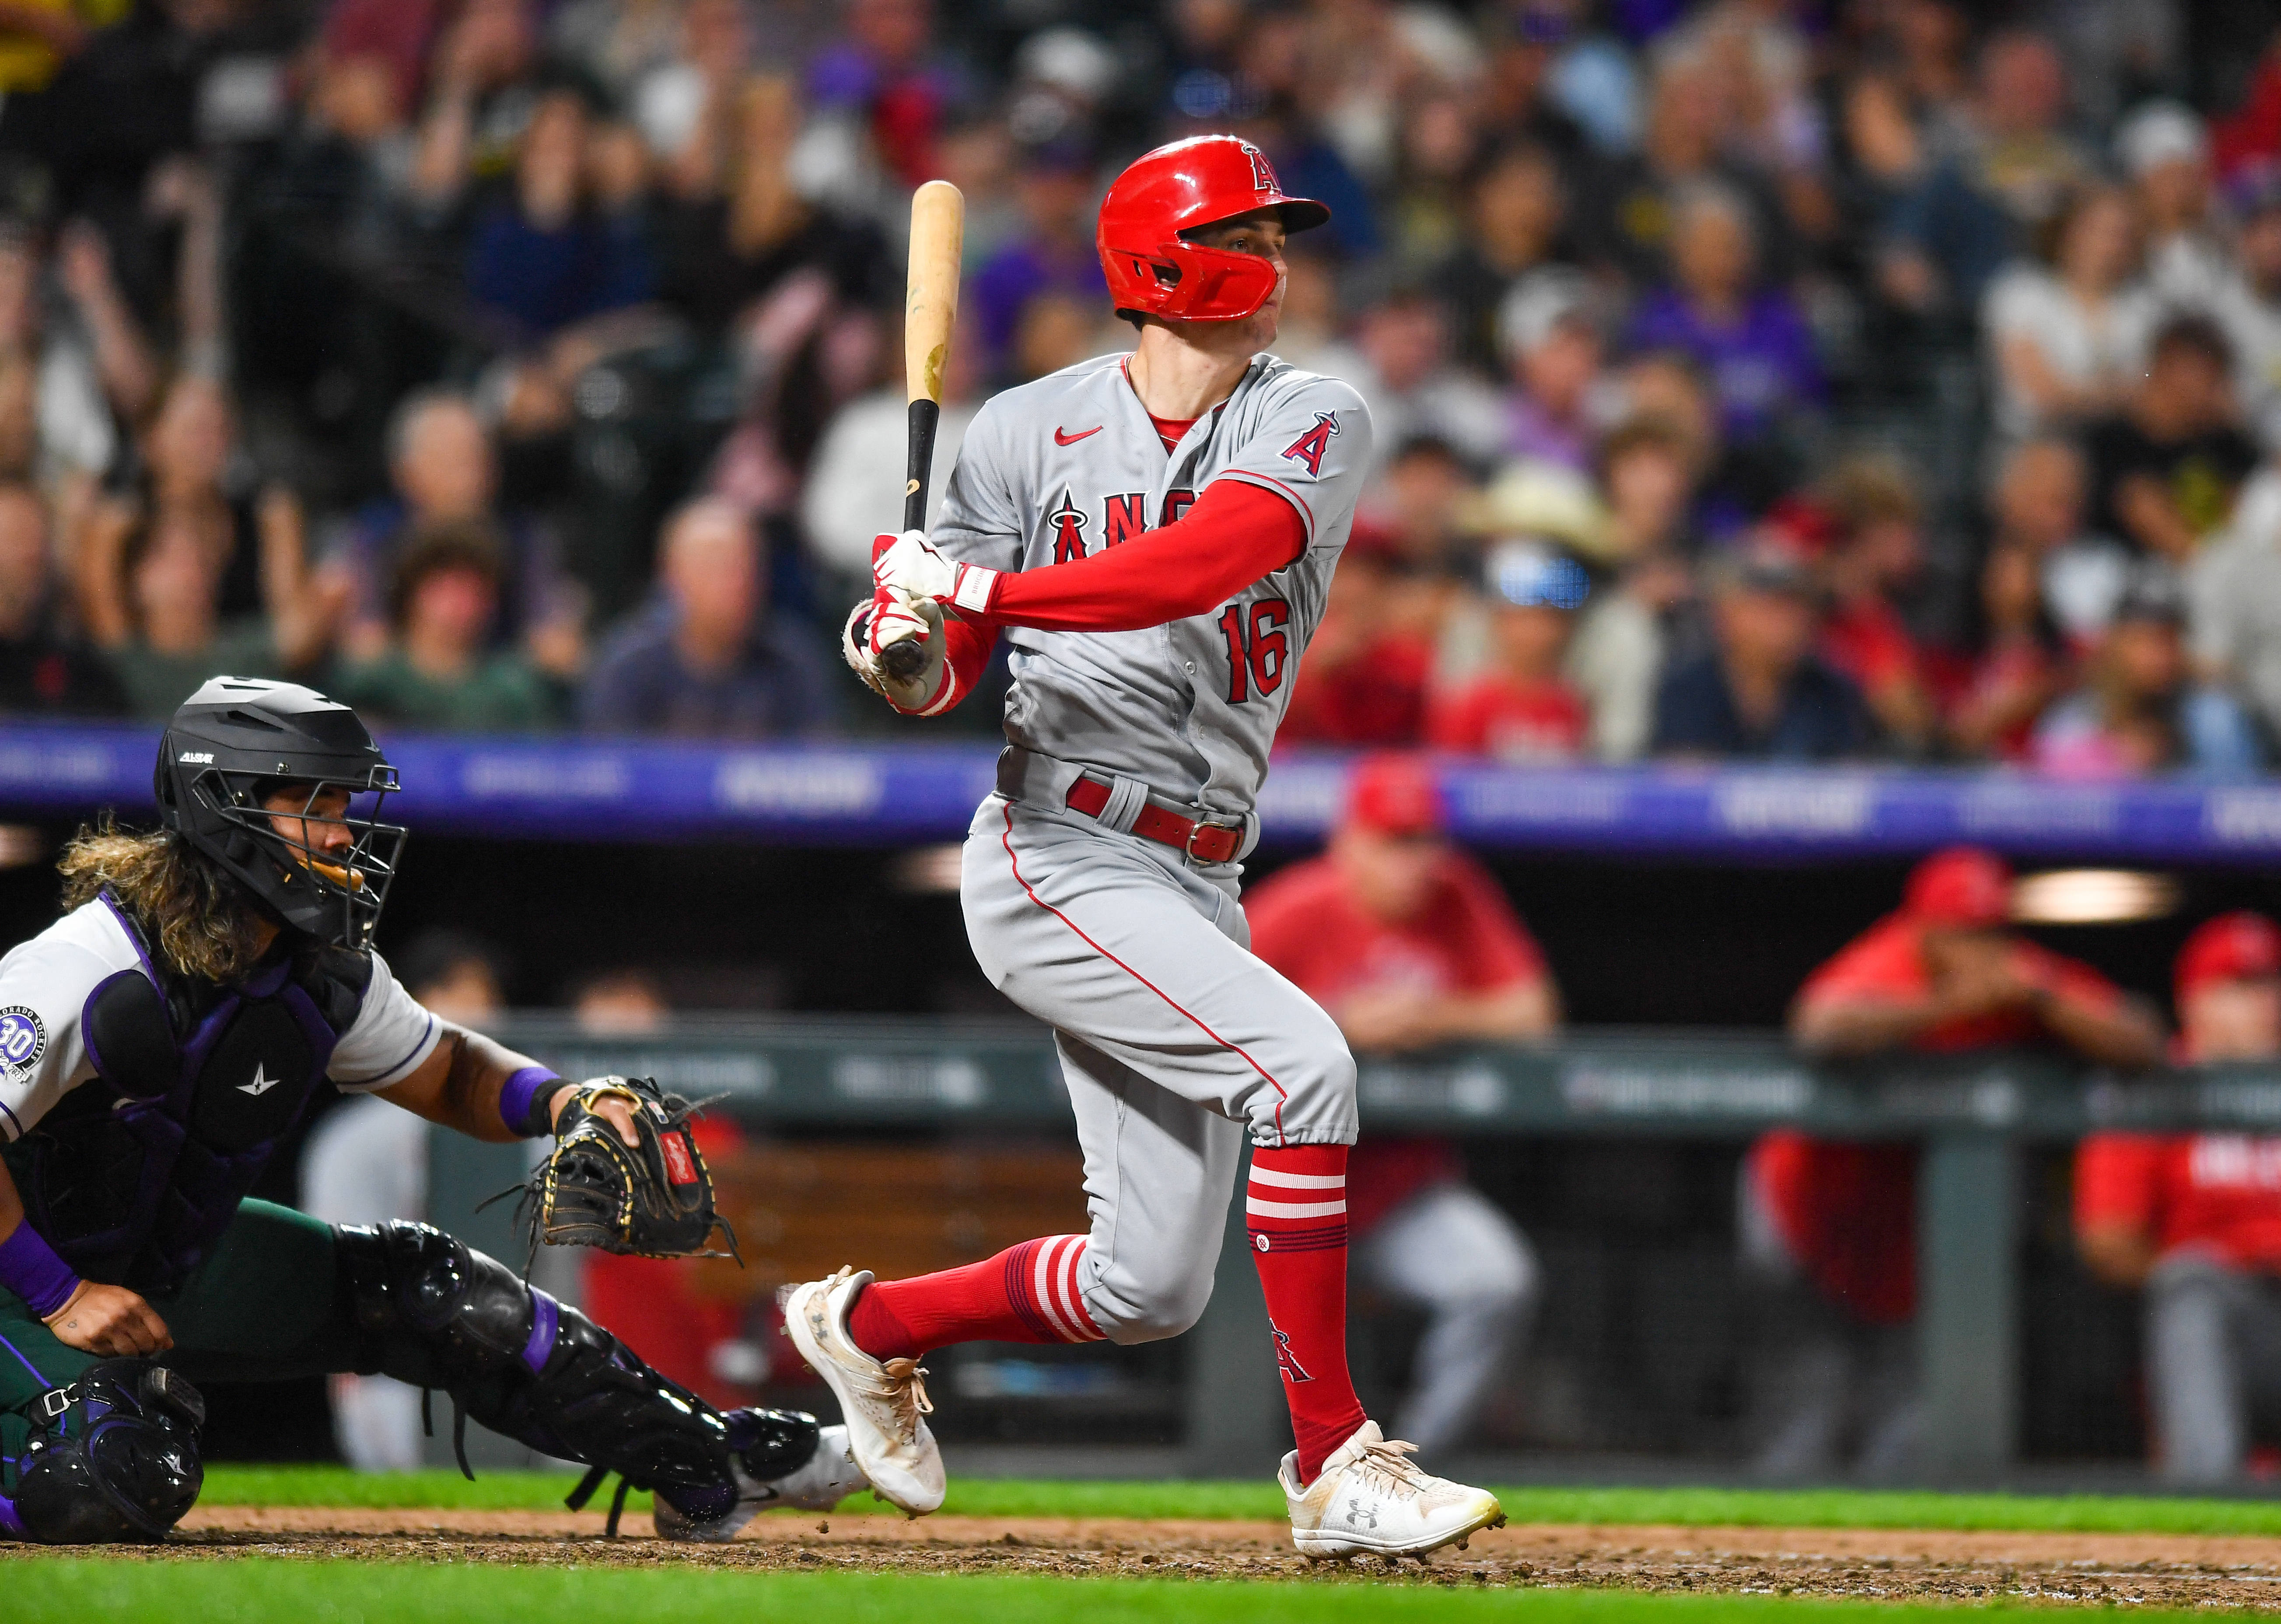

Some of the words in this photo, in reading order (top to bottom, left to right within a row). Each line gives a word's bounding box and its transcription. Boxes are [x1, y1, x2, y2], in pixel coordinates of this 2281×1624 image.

[1241, 139, 1280, 191] A
[1276, 408, 1341, 482] A
[1217, 598, 1289, 704] 16
[0, 1006, 34, 1018] ORADO
[30, 1018, 45, 1061] ROCKIES
[0, 1018, 34, 1057] 30
[8, 1065, 24, 1080] 2023
